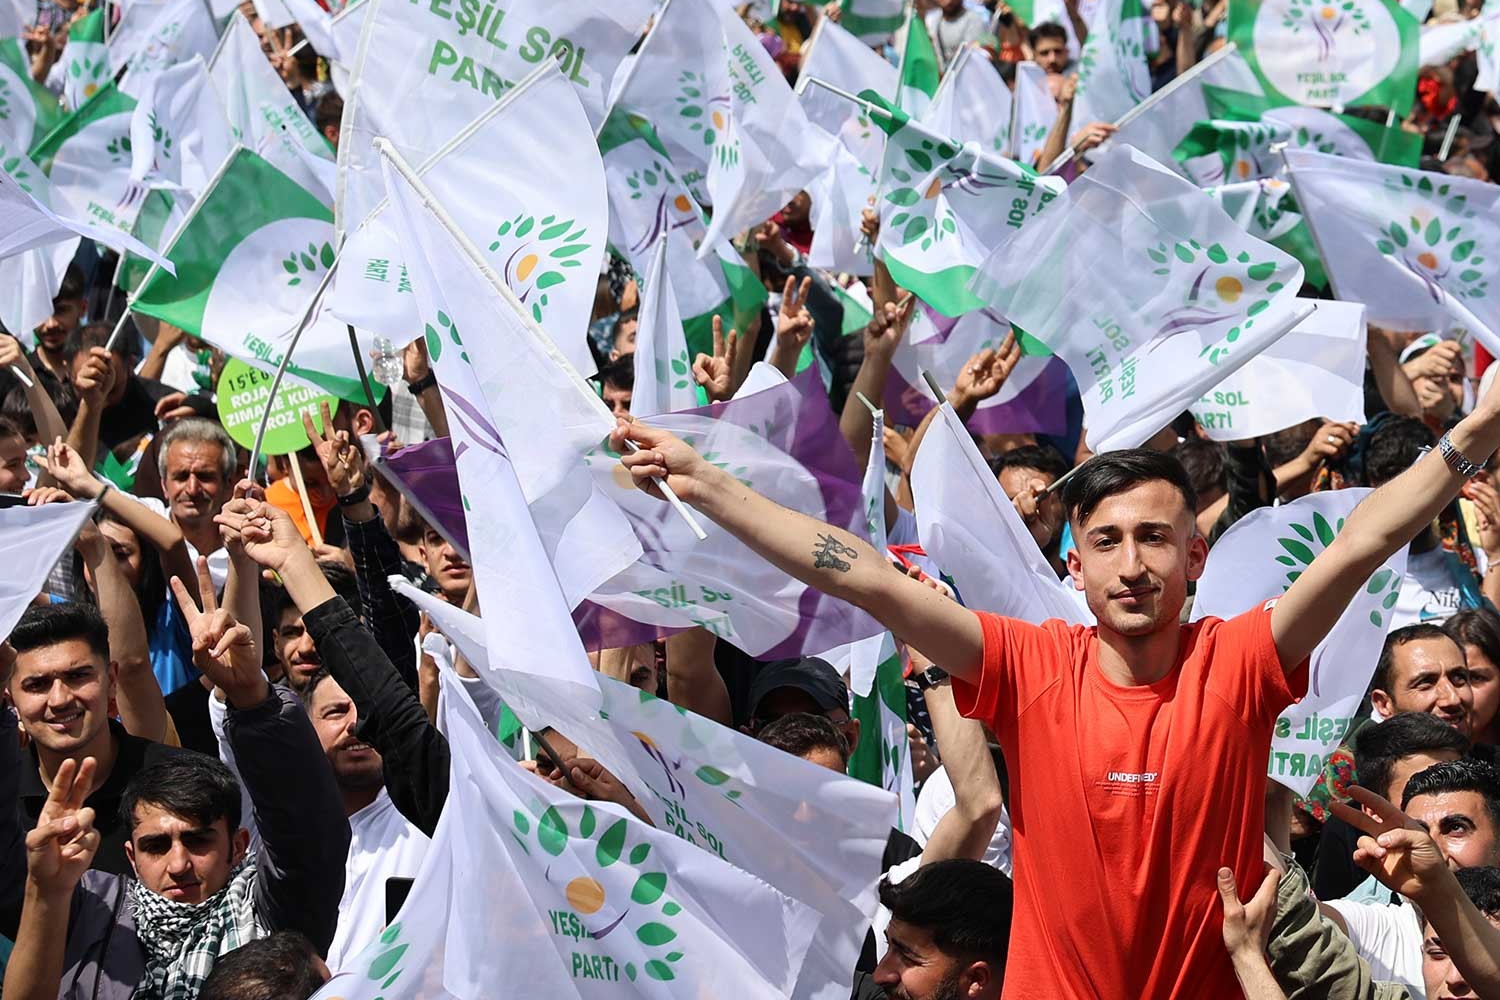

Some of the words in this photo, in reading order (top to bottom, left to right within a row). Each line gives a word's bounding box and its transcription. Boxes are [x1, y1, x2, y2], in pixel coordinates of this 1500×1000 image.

[519, 26, 589, 88] SOL
[1214, 391, 1249, 406] SOL
[251, 410, 297, 436] PROZ
[1429, 590, 1459, 609] Nik
